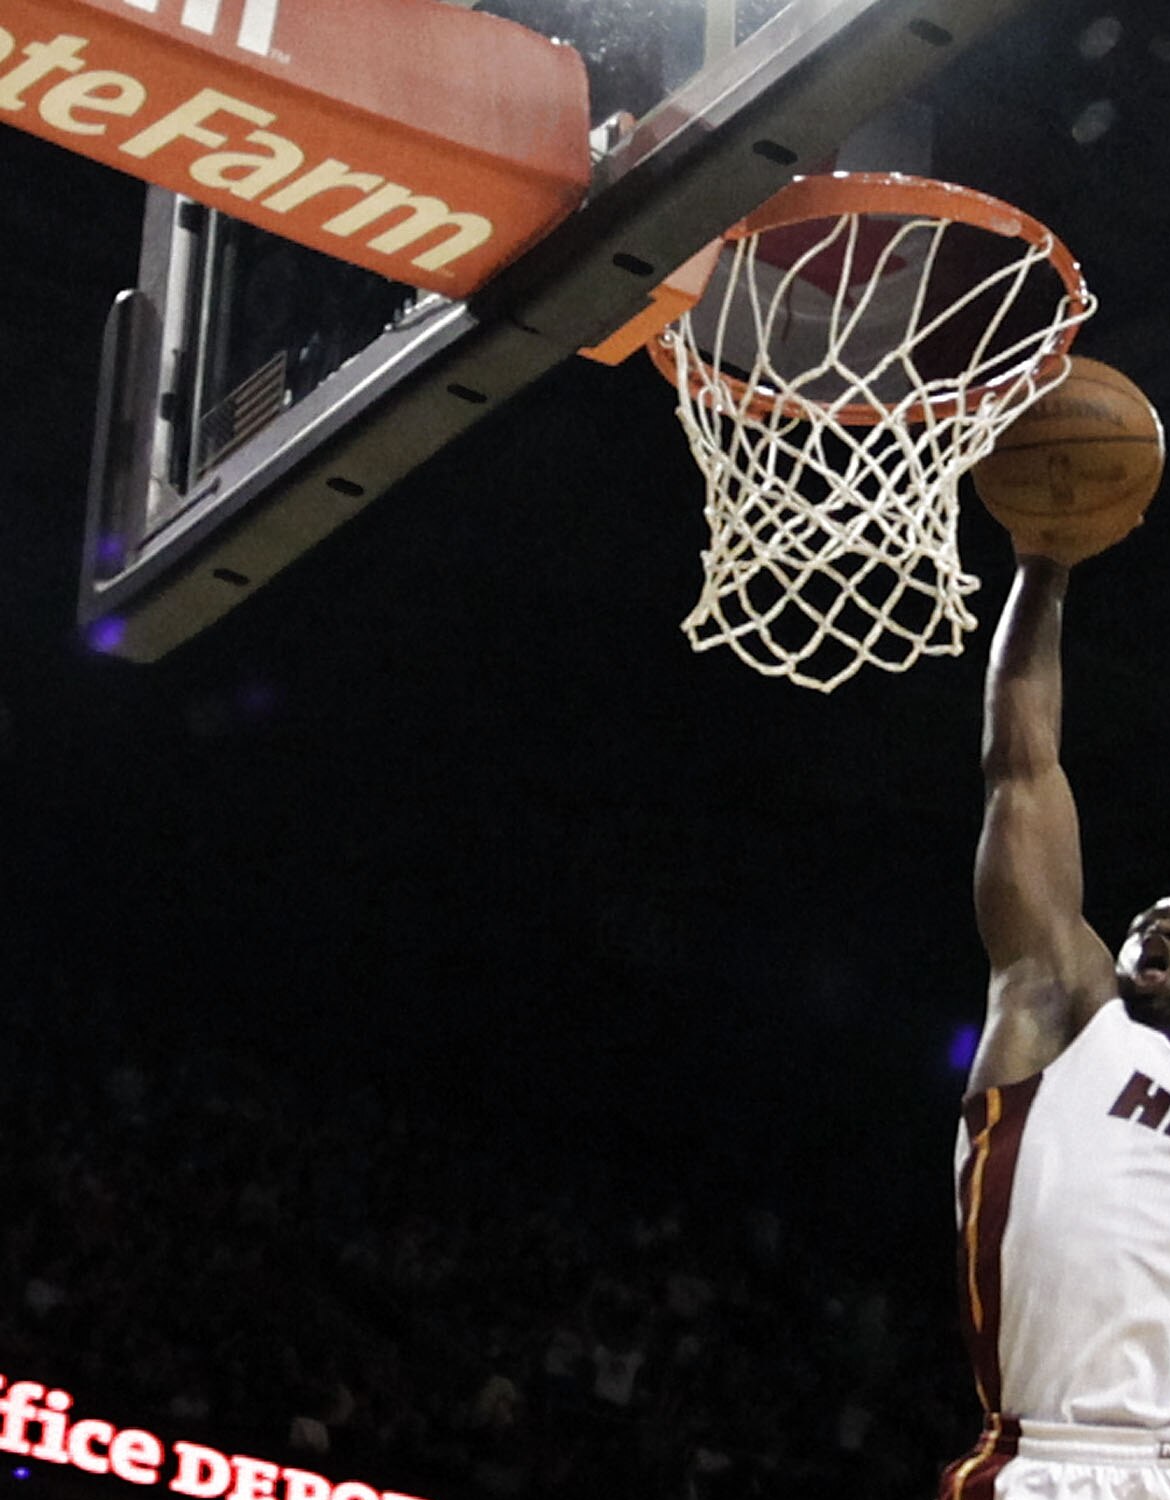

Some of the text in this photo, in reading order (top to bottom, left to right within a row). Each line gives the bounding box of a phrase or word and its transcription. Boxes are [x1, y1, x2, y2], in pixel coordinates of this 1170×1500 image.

[0, 27, 494, 272] te Farm
[0, 1374, 164, 1485] fice
